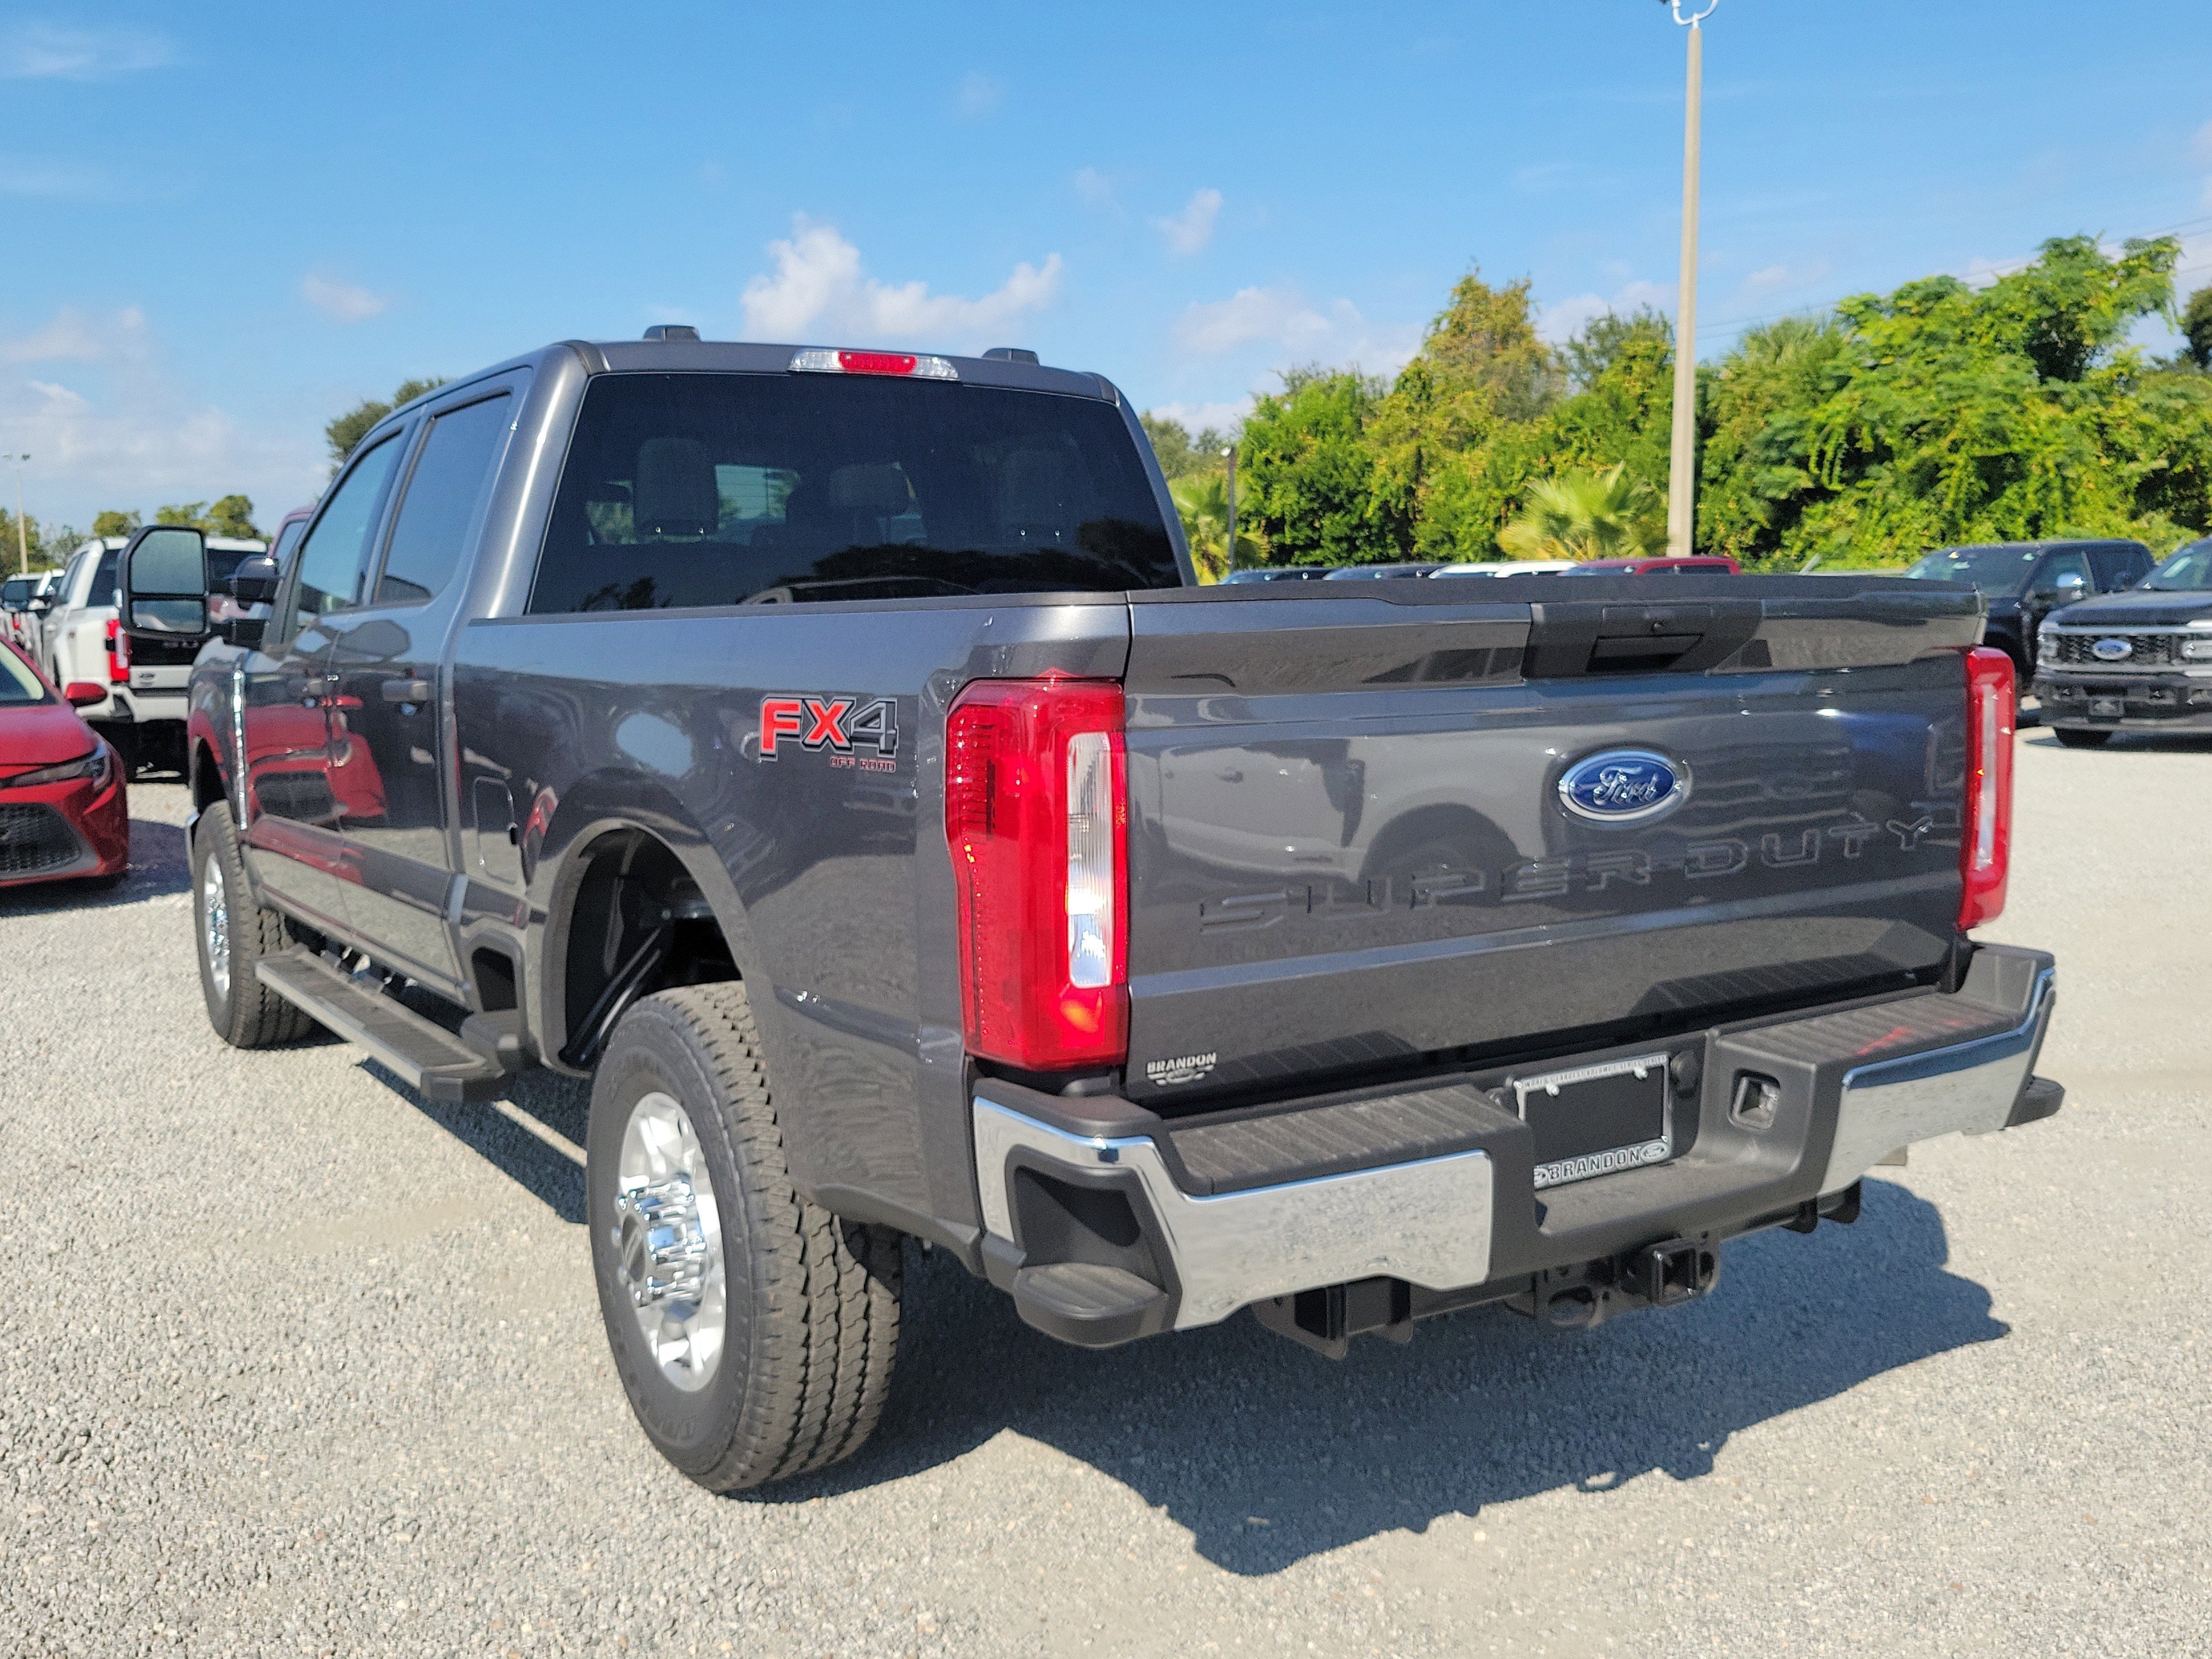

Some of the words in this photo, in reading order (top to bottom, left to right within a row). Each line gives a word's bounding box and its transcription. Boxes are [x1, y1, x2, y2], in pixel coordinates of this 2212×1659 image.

[759, 694, 899, 761] FX4
[830, 757, 855, 769] OFF
[860, 759, 896, 772] ROAD
[1593, 766, 1658, 805] Ford
[1199, 849, 1651, 933] SUPER
[1684, 815, 1933, 879] DUTY
[1147, 1052, 1217, 1073] BRANDON
[1548, 1147, 1642, 1182] BRANDON
